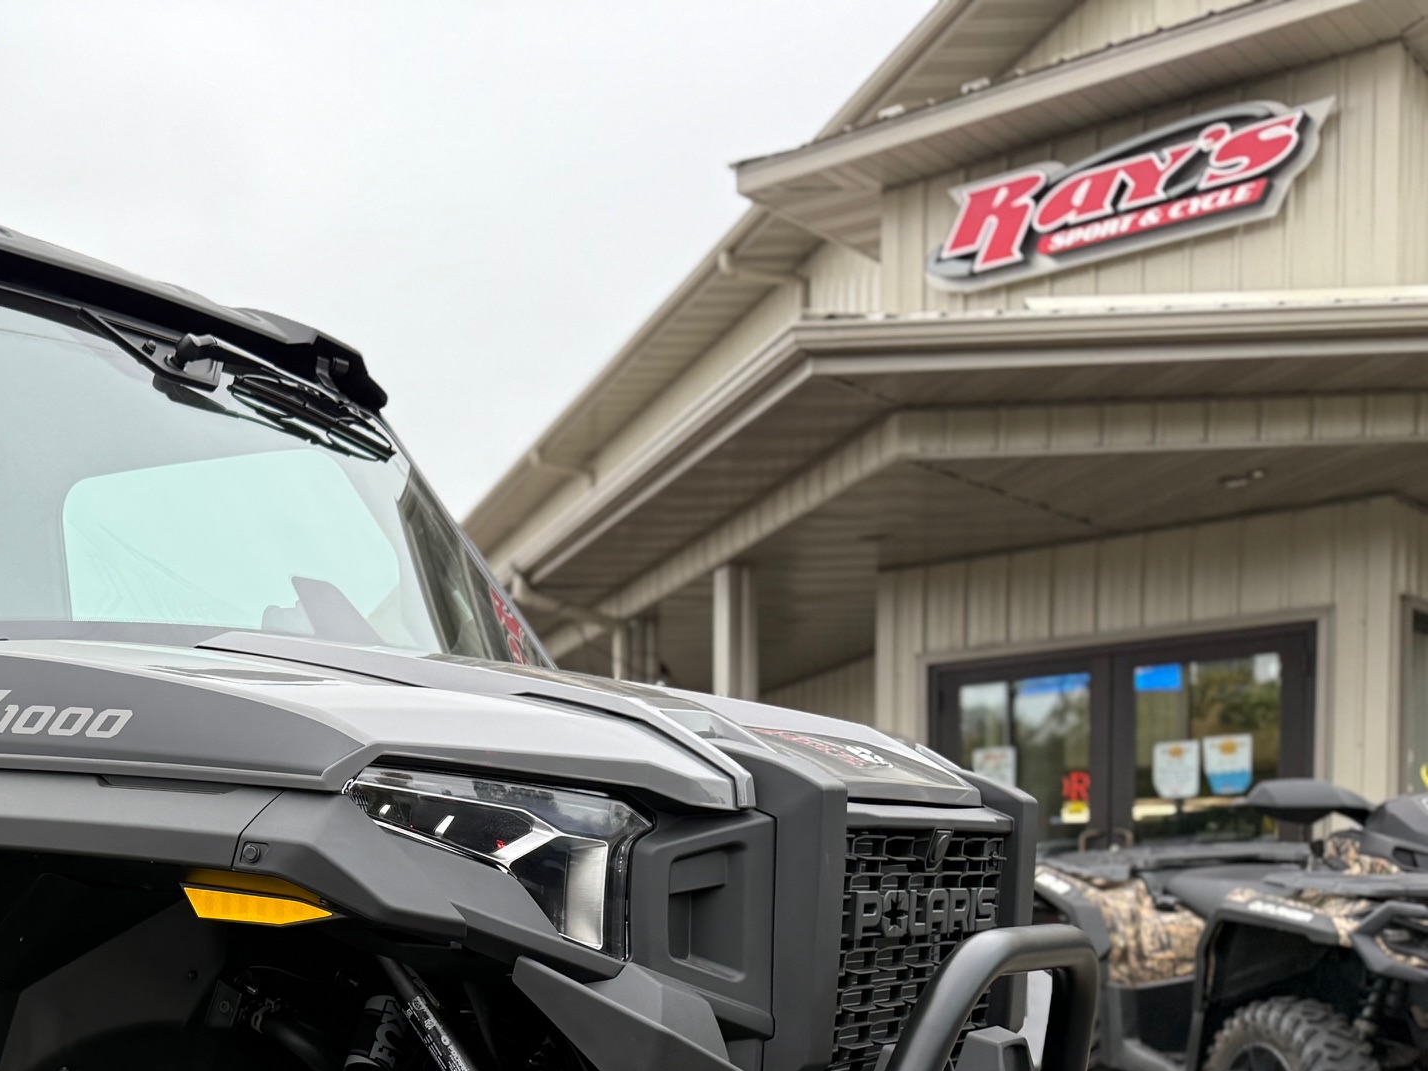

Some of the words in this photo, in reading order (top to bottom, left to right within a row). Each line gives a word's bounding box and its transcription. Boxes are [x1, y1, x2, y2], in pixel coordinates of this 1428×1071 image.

[1047, 215, 1131, 251] SPORT
[1138, 206, 1164, 228] &
[1169, 183, 1256, 218] CYCLE
[852, 888, 997, 940] POLARIS
